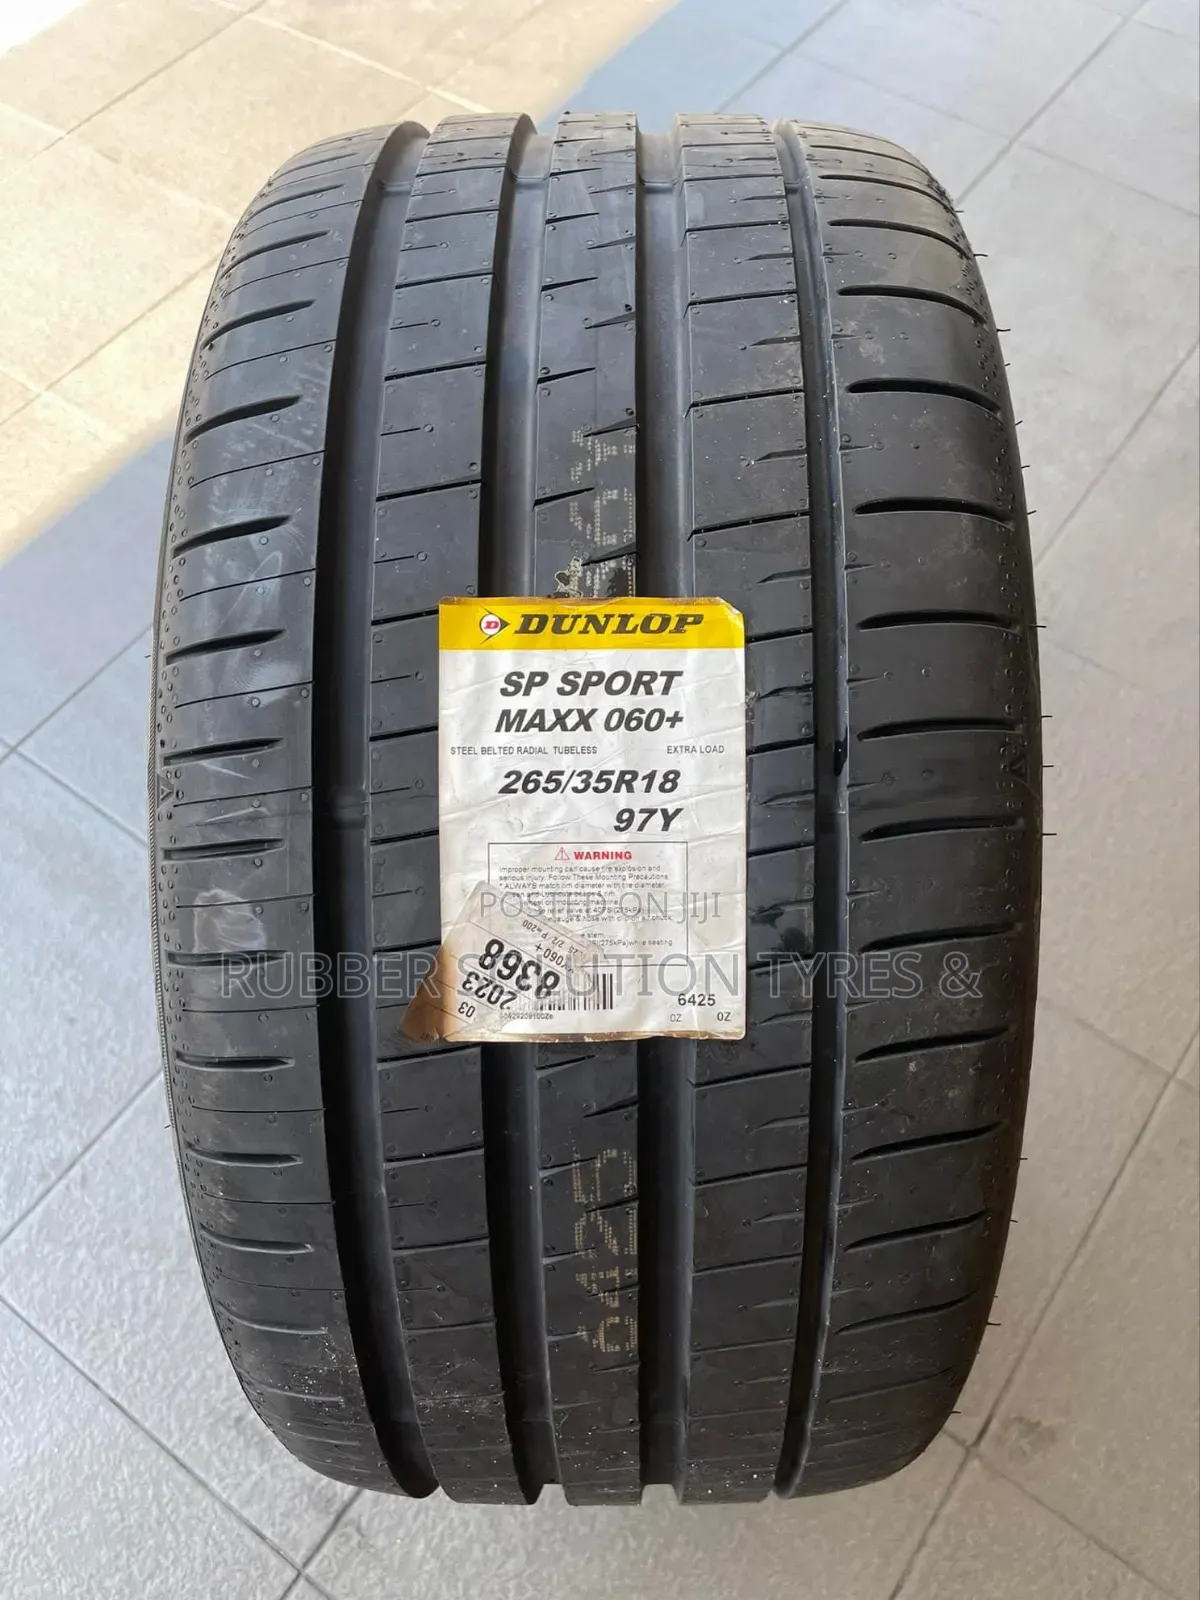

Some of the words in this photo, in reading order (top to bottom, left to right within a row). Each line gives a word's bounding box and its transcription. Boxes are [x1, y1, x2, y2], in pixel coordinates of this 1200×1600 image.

[514, 613, 704, 635] DUNLOP
[500, 671, 549, 697] SP
[556, 670, 684, 697] SPORT
[495, 708, 598, 733] MAXX
[604, 707, 684, 732] 060+
[450, 746, 478, 755] STEEL
[481, 746, 514, 755] BELTED
[517, 746, 548, 755] RADIAL
[553, 745, 597, 755] TUBELESS
[667, 745, 697, 754] EXTRA
[700, 745, 725, 754] LOAD
[498, 769, 681, 794] 265/35R18
[614, 808, 684, 832] 97Y
[573, 850, 632, 860] WARNING
[504, 882, 537, 890] ALWAYS
[478, 938, 560, 1000] 8368
[462, 971, 517, 1010] 2023
[677, 993, 716, 1007] 6425
[458, 1001, 476, 1018] 03
